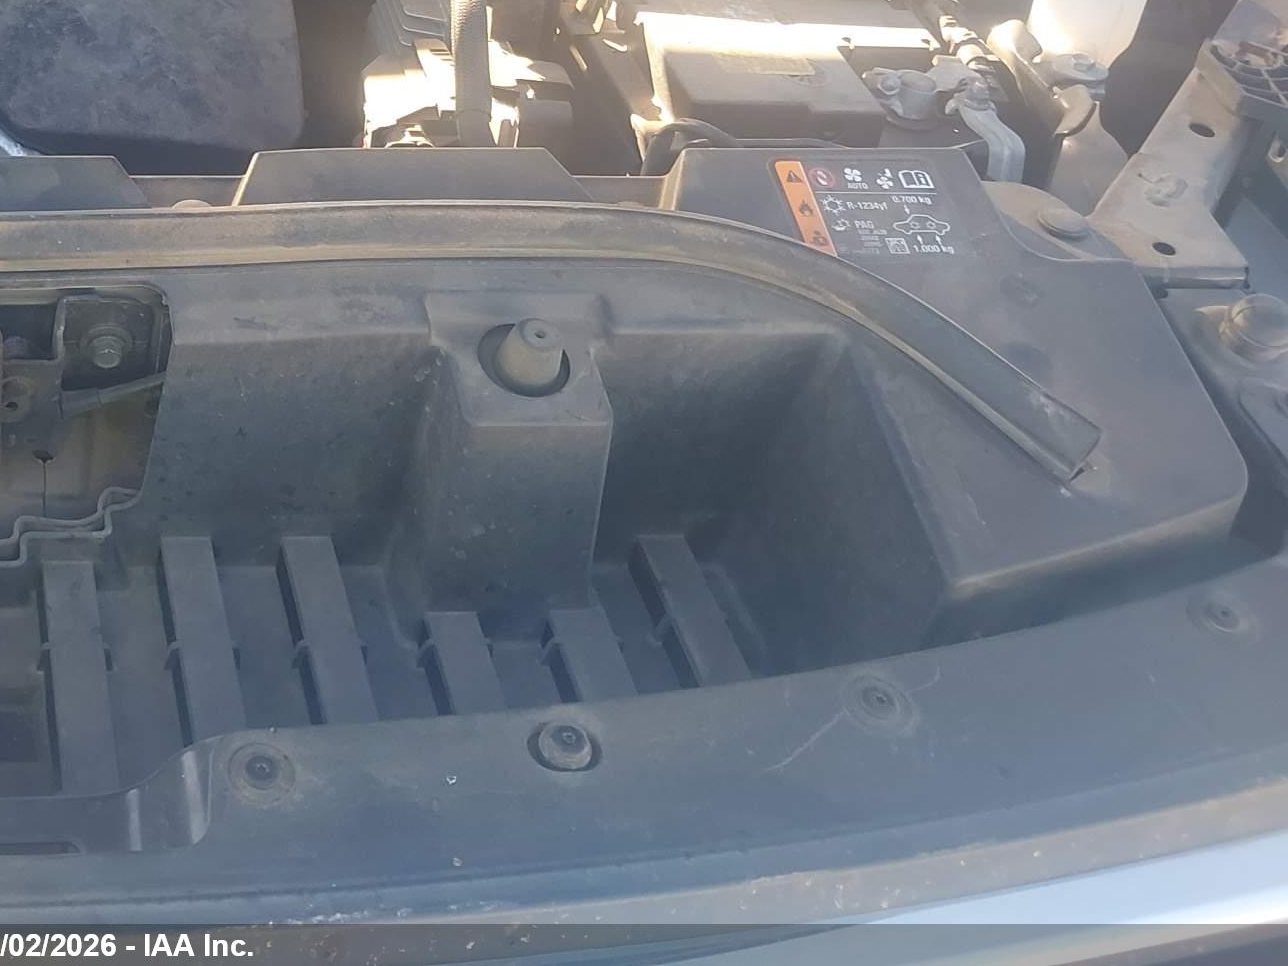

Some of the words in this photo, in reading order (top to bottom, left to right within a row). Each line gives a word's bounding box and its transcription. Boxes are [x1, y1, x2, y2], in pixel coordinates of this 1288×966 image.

[918, 196, 932, 205] kg
[854, 220, 875, 229] PAG
[941, 244, 955, 255] kg
